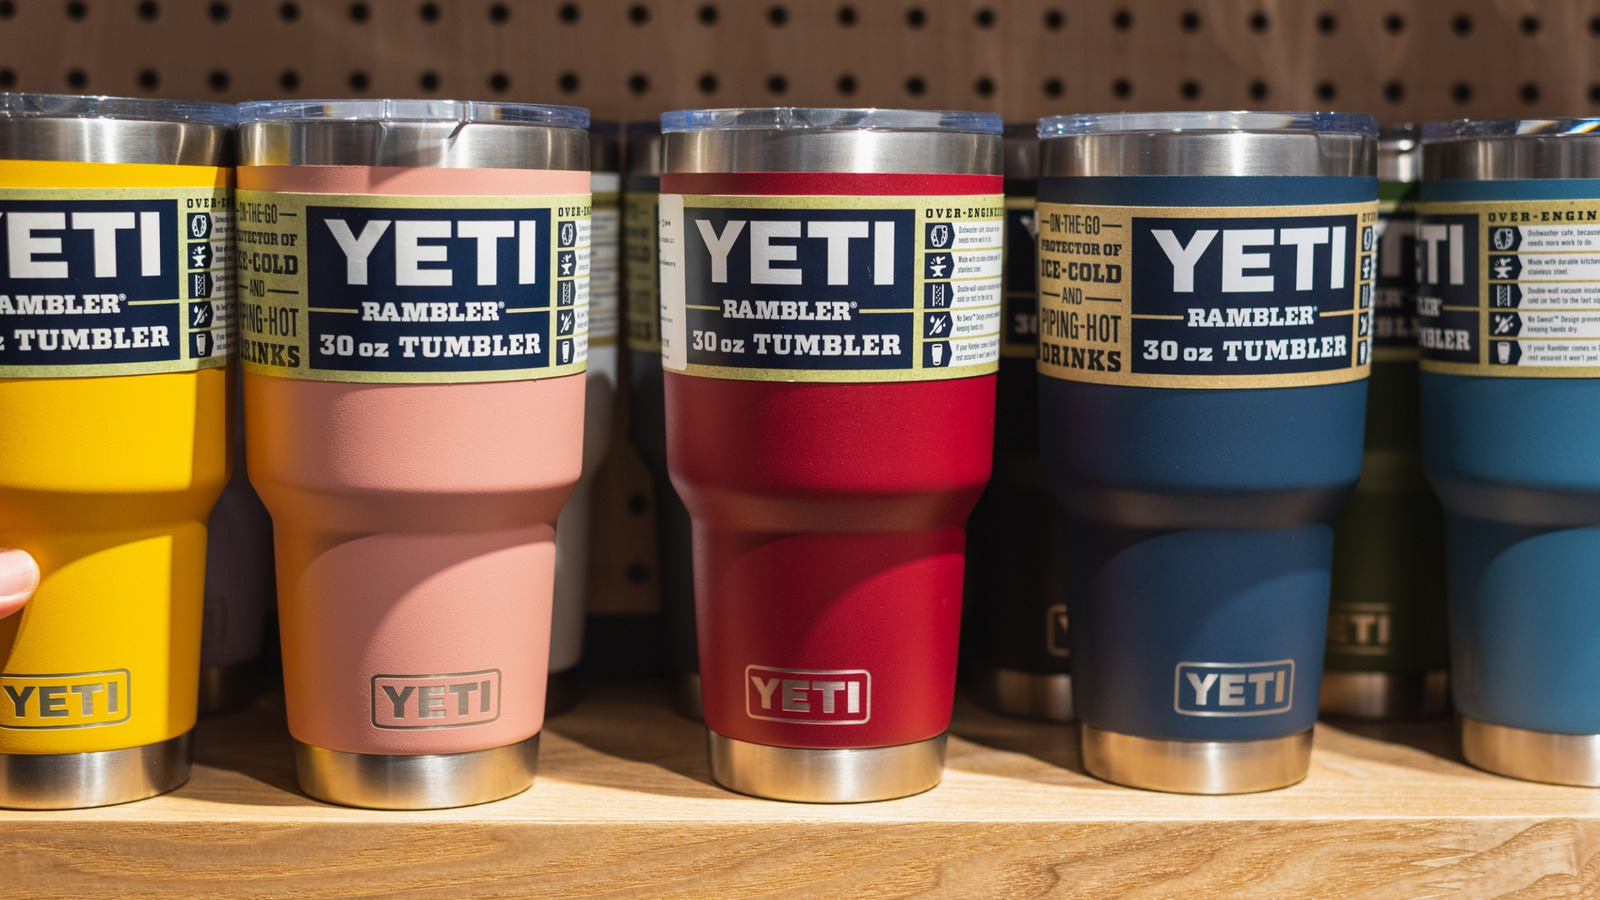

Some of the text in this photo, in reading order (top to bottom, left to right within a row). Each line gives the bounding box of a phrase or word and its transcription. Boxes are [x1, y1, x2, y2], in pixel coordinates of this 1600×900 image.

[1050, 213, 1100, 236] ON-THE-GO
[1488, 210, 1597, 222] OVER-ENGIN
[0, 211, 161, 278] ETI
[281, 233, 298, 247] OF
[1527, 229, 1559, 237] Dishwasher
[323, 219, 536, 286] YETI
[694, 219, 895, 286] YETI
[1041, 239, 1122, 257] PROTECTOR OF
[1150, 226, 1347, 293] YETI
[1041, 258, 1122, 284] ICE-COLD
[250, 278, 265, 297] AND
[1062, 287, 1082, 305] AND
[1041, 307, 1122, 344] PIPING-HOT
[1527, 326, 1548, 334] keeping
[1561, 315, 1579, 324] Design
[14, 326, 170, 351] TUMBLER
[320, 333, 541, 358] 30 oz TUMBLER
[692, 330, 717, 352] 30
[720, 338, 745, 354] oz
[753, 333, 901, 356] TUMBLER
[1142, 335, 1347, 362] 30 oz TUMBLER
[1042, 341, 1122, 373] DRINKS
[1586, 354, 1598, 362] peel
[3, 682, 119, 718] YETI
[381, 680, 491, 718] YETI
[750, 676, 861, 713] YETI
[1186, 670, 1287, 707] YETI
